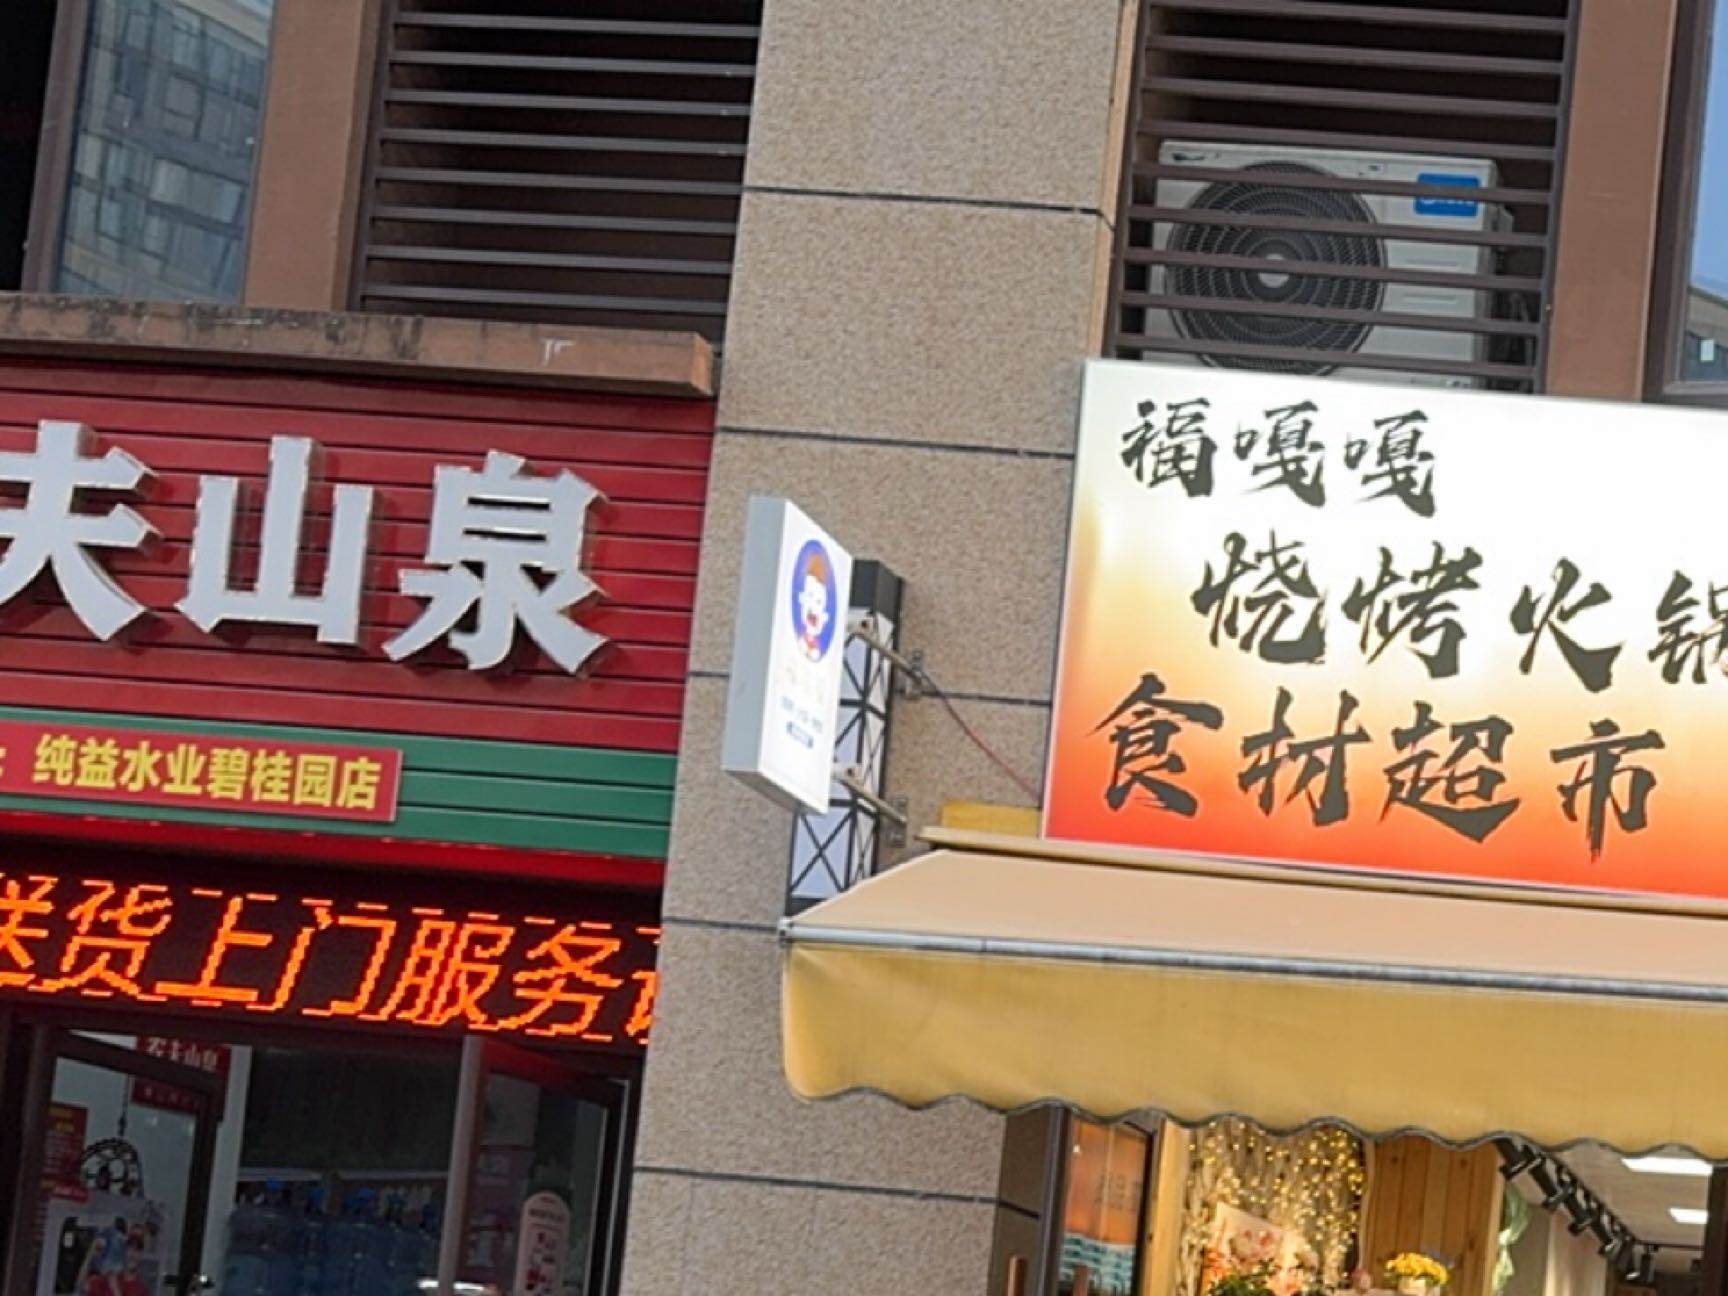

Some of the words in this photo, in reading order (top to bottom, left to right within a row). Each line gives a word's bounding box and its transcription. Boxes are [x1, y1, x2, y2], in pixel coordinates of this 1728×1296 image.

[1121, 398, 1437, 517] 福嘎嘎
[0, 419, 609, 674] 夫山泉
[32, 733, 383, 811] 纯益水业碧桂园店
[1086, 672, 1666, 863] 食材超市
[0, 880, 660, 1036] 送货上门服务
